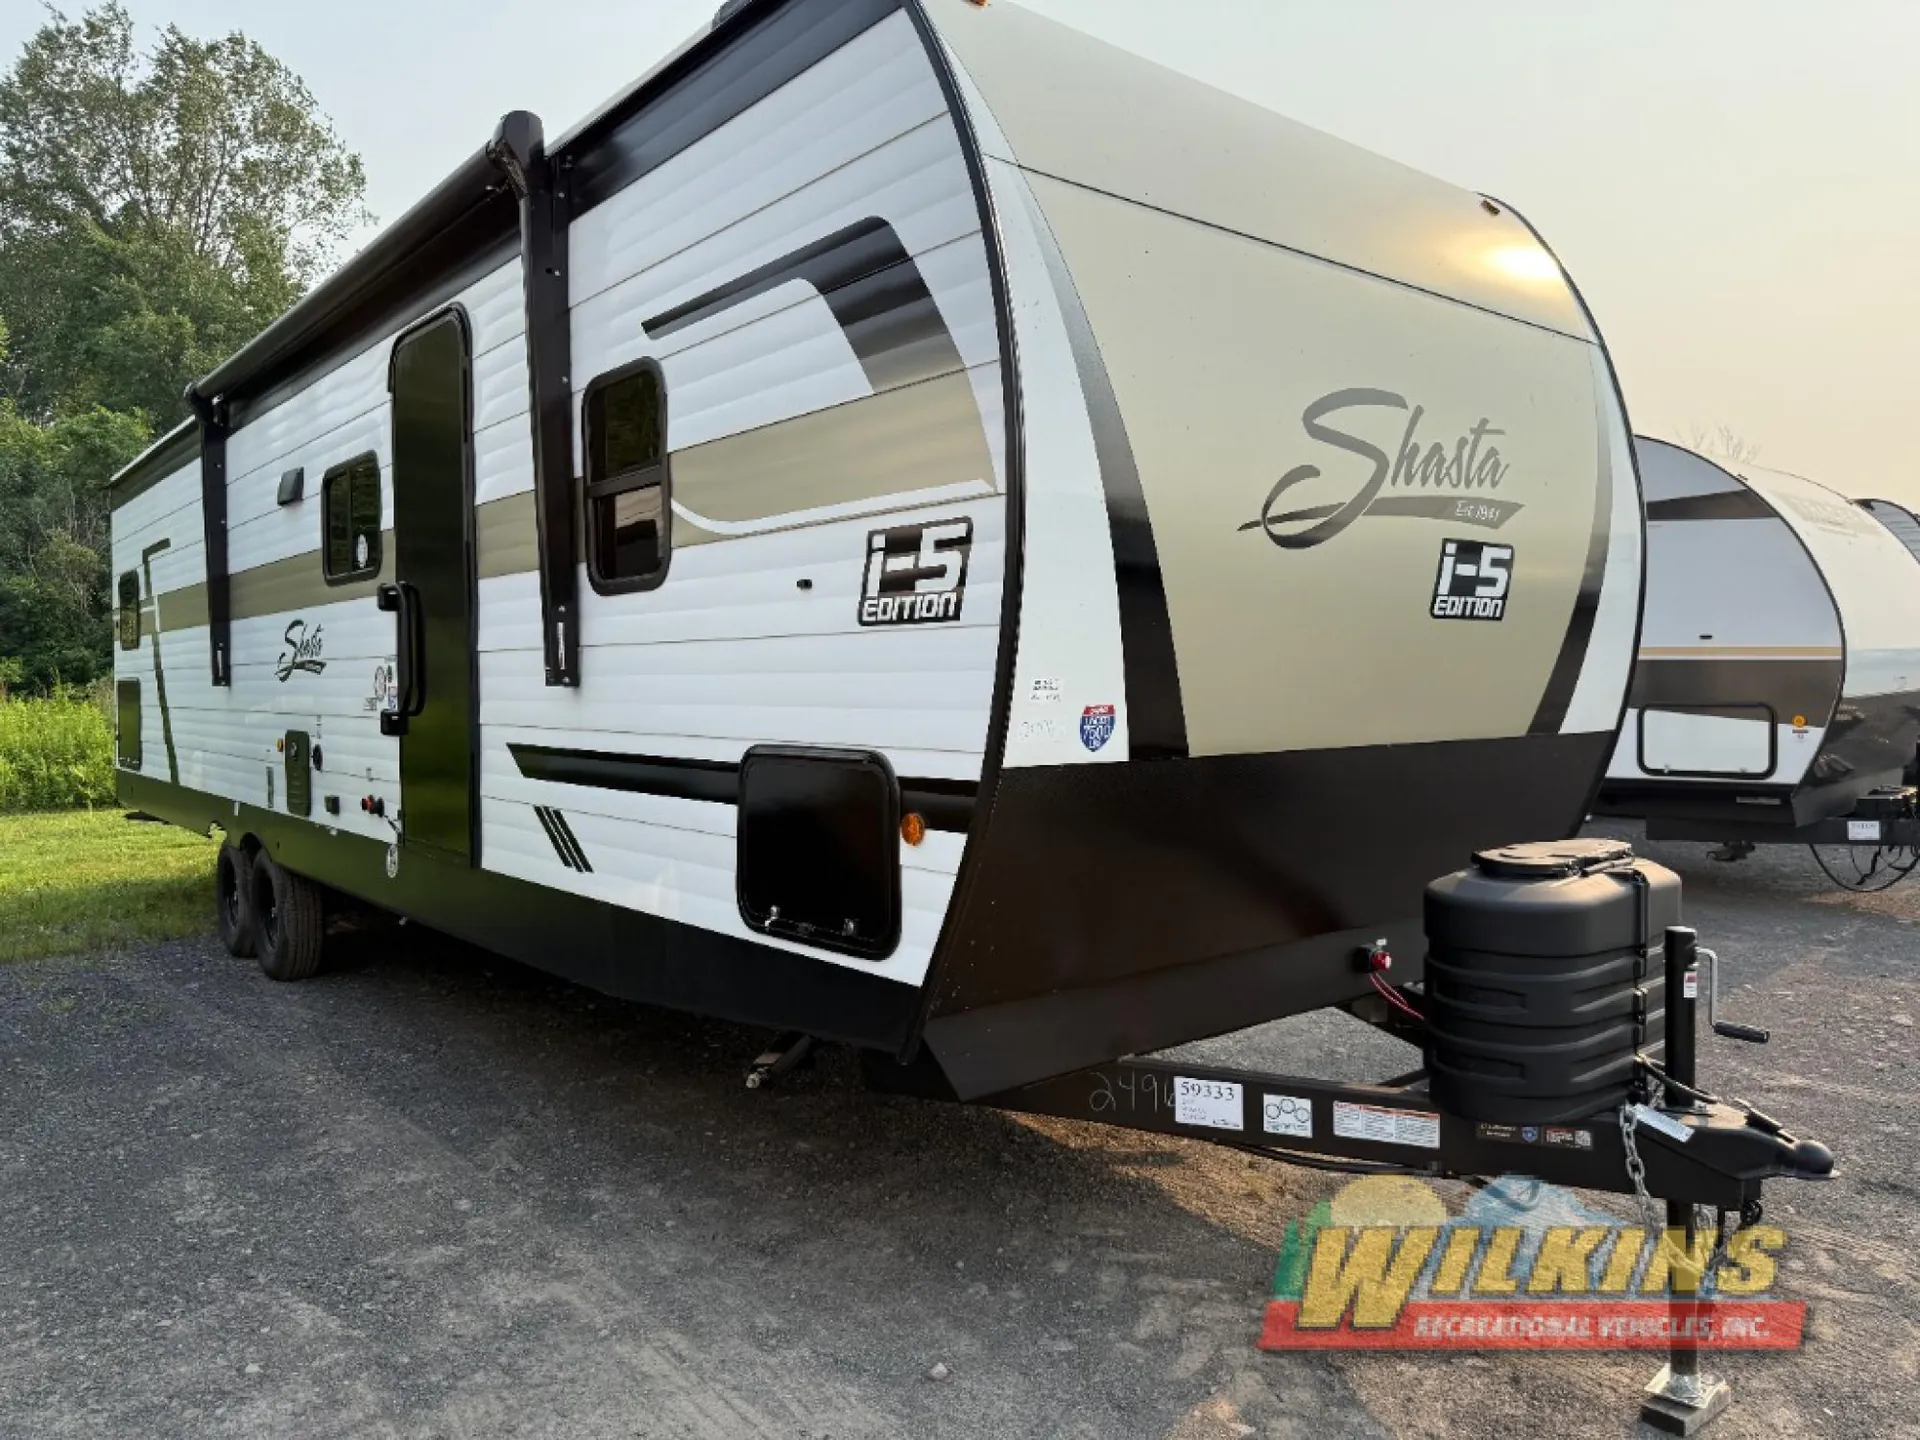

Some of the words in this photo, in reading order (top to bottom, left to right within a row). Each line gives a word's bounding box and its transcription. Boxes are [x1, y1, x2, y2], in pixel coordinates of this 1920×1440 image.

[1261, 387, 1511, 549] Shasta
[866, 522, 968, 598] i-5
[1437, 542, 1513, 598] i-5
[861, 592, 957, 622] EDITION
[1433, 595, 1503, 618] EDITION
